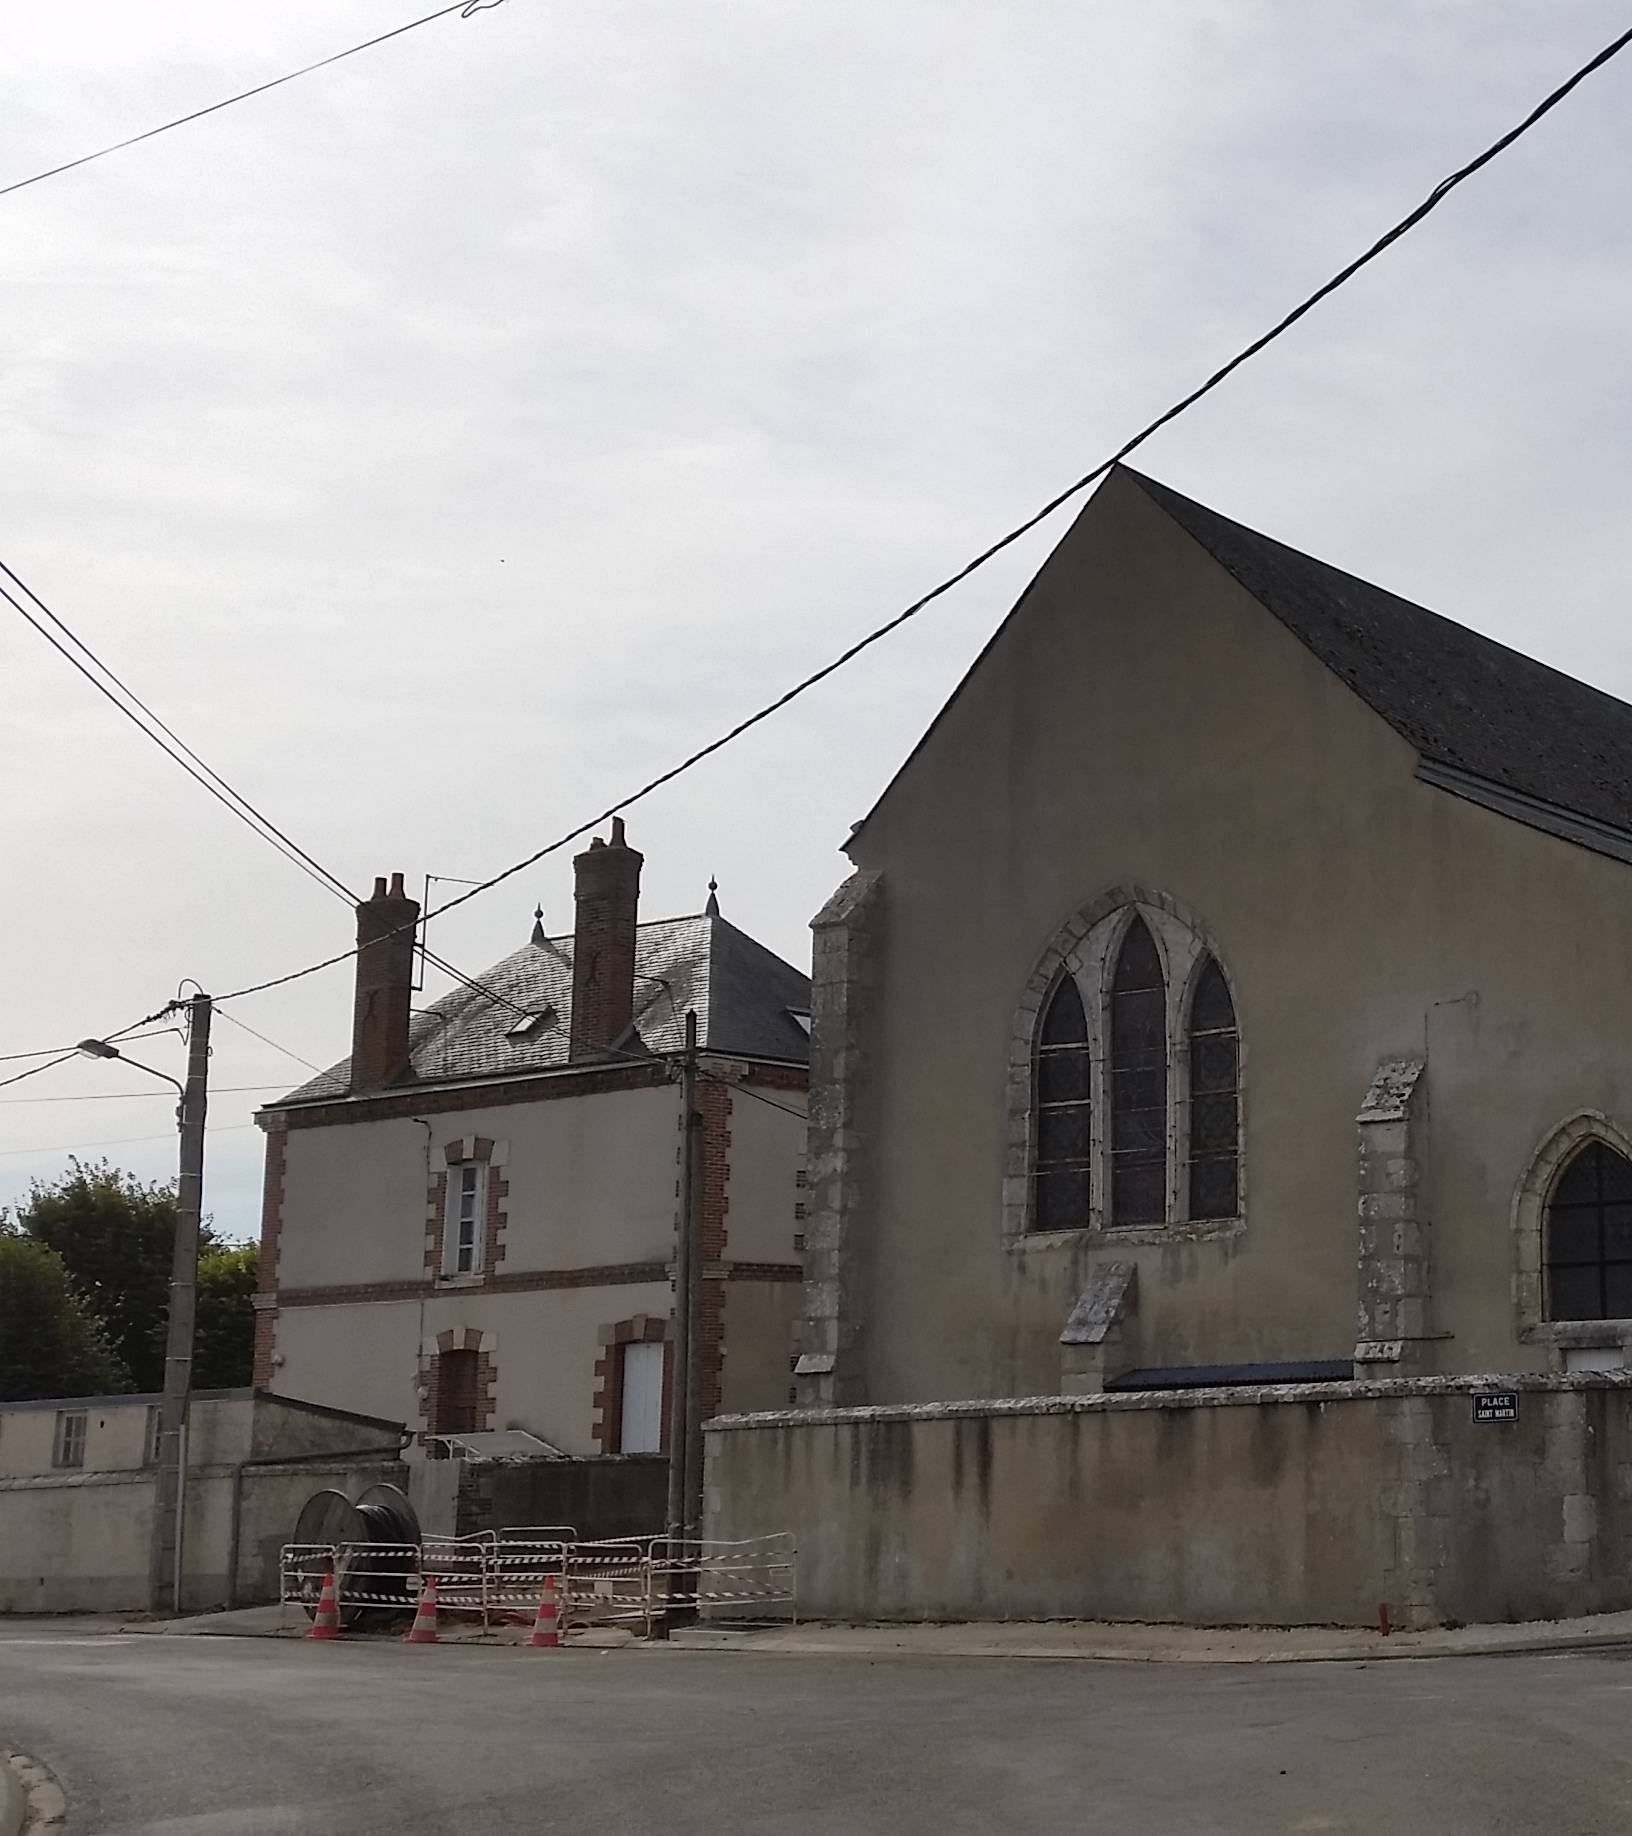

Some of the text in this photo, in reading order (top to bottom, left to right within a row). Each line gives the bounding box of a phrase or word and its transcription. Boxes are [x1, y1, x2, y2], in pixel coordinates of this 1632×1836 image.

[1481, 1397, 1510, 1407] PLACE
[1478, 1408, 1514, 1418] SAINT MARTIN
